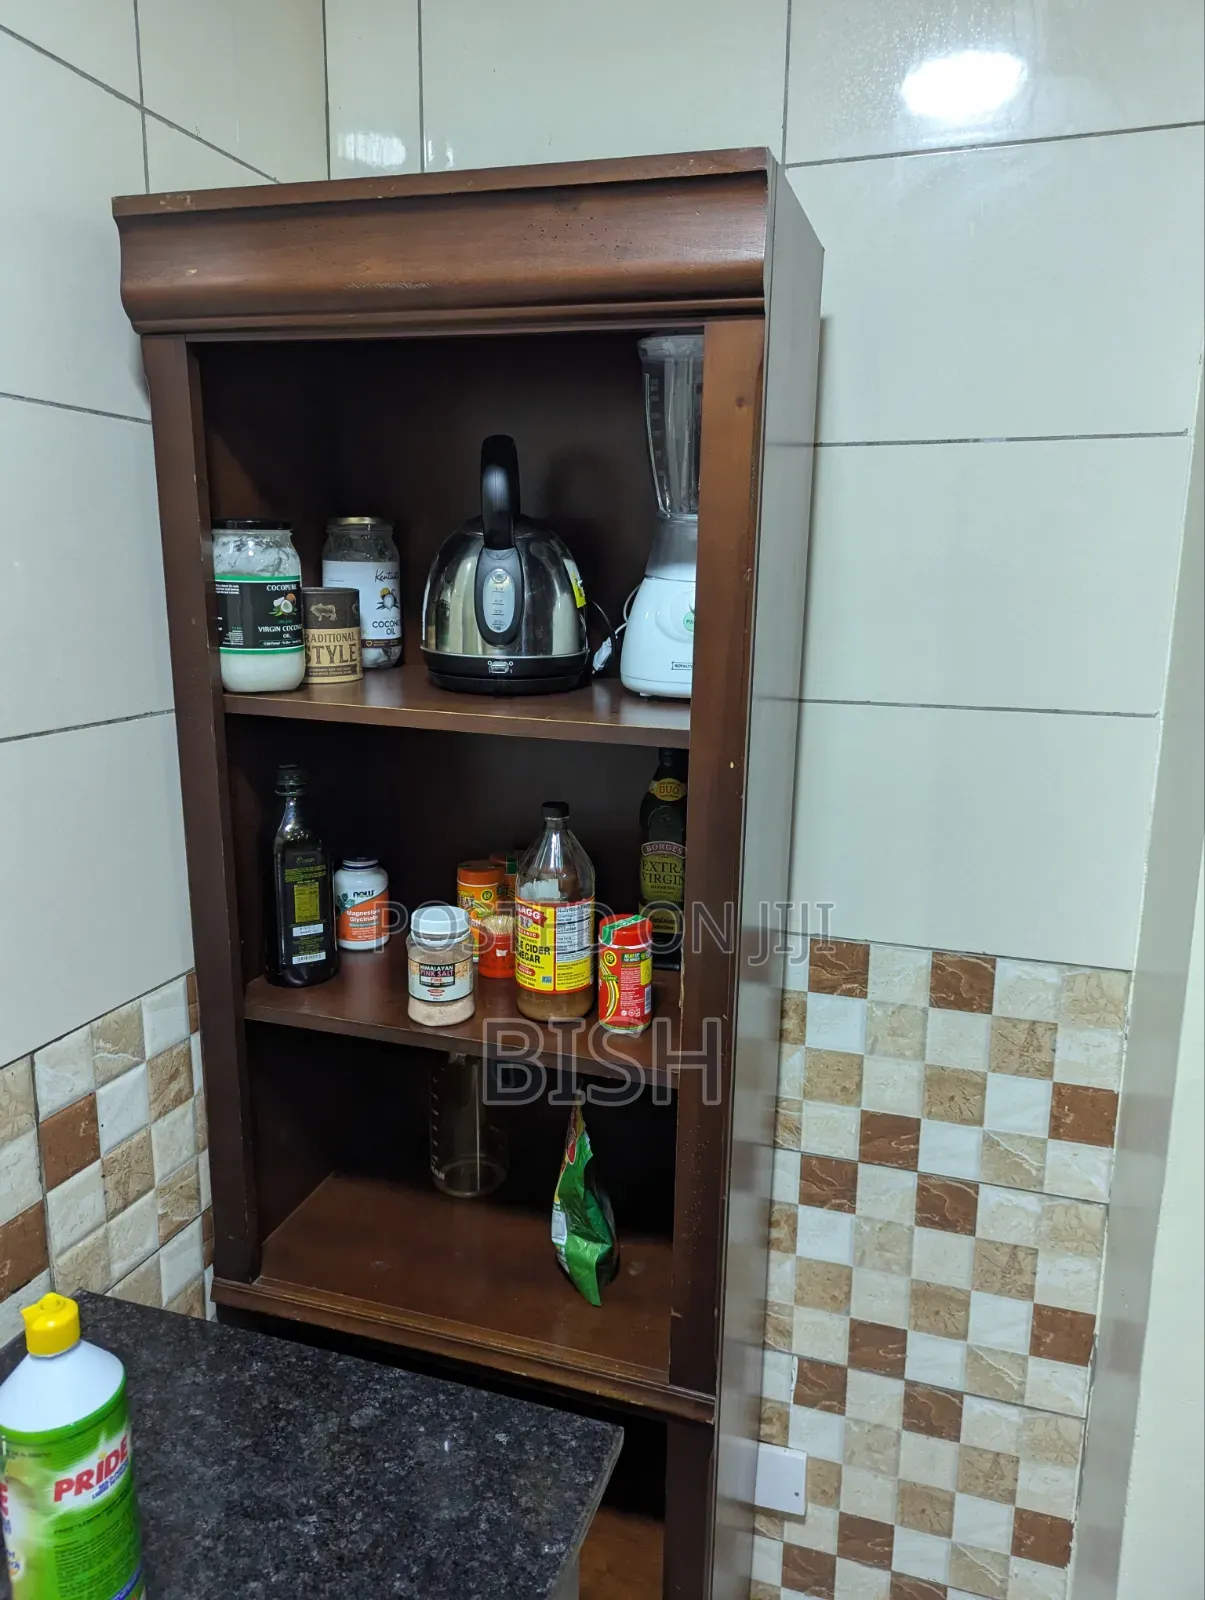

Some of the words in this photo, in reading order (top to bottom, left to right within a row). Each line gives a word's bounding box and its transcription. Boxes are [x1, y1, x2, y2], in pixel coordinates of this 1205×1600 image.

[372, 620, 400, 629] COCON
[386, 628, 396, 636] OIL
[305, 632, 356, 643] RADITIONAL
[659, 785, 679, 794] DUO
[646, 843, 683, 855] BORGES
[525, 943, 551, 956] CIDER
[437, 969, 454, 977] SALT
[54, 1433, 129, 1503] PRIDE
